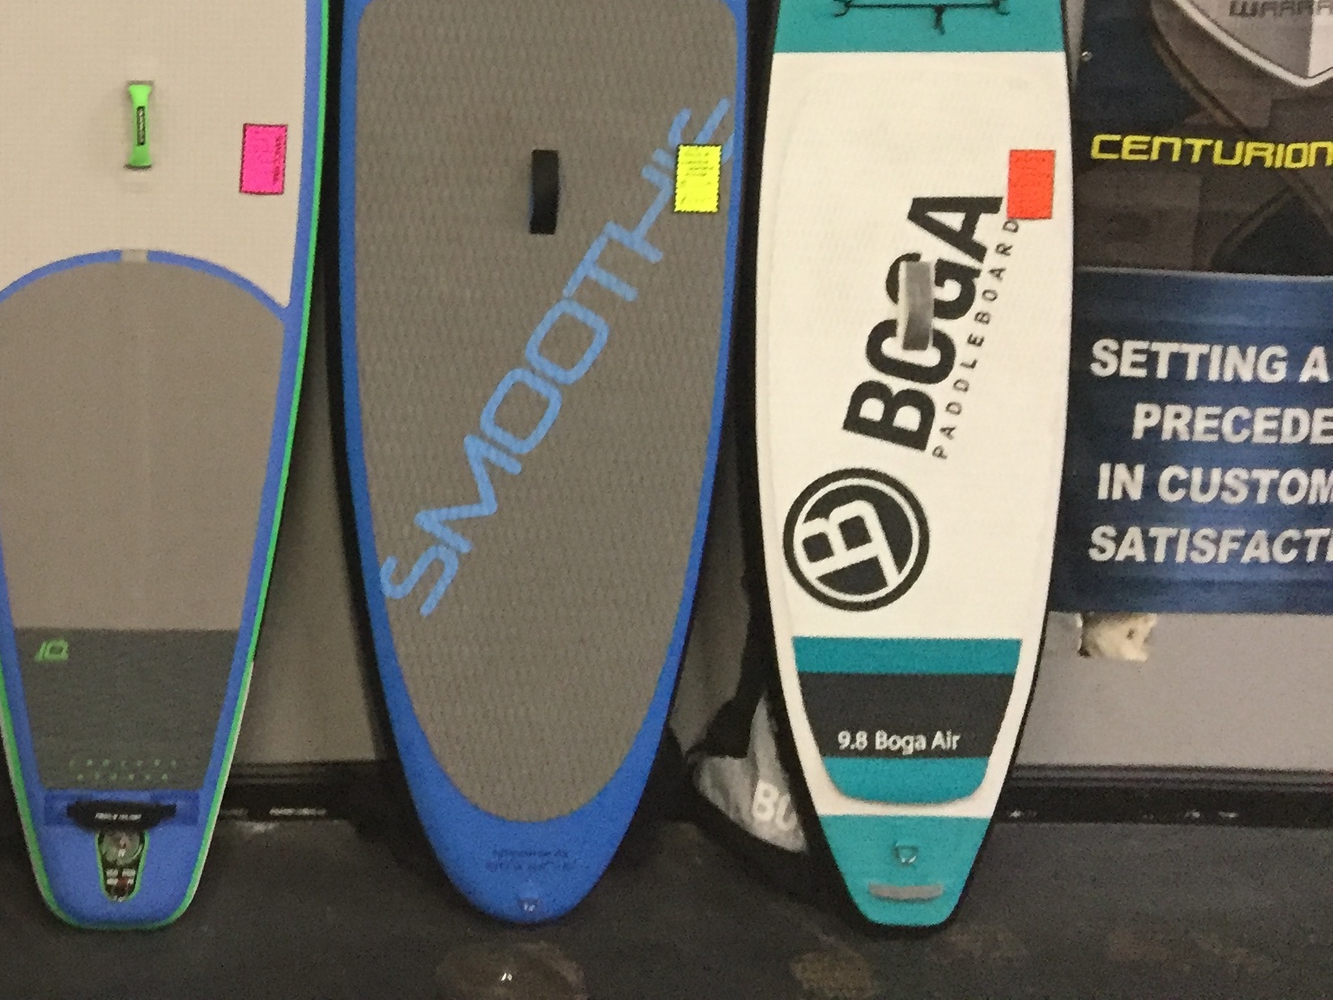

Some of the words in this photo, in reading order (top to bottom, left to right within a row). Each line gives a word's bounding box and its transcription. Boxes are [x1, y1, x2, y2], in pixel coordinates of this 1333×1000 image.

[1090, 133, 1333, 169] CENTURION
[931, 219, 1021, 461] PADDLEBOARD
[1090, 338, 1288, 383] SETTING
[1298, 346, 1331, 383] A
[1131, 402, 1333, 445] PRECEDE
[1097, 462, 1146, 501] IN
[837, 730, 868, 750] 9.8
[874, 730, 927, 755] Boga
[931, 730, 961, 750] Air
